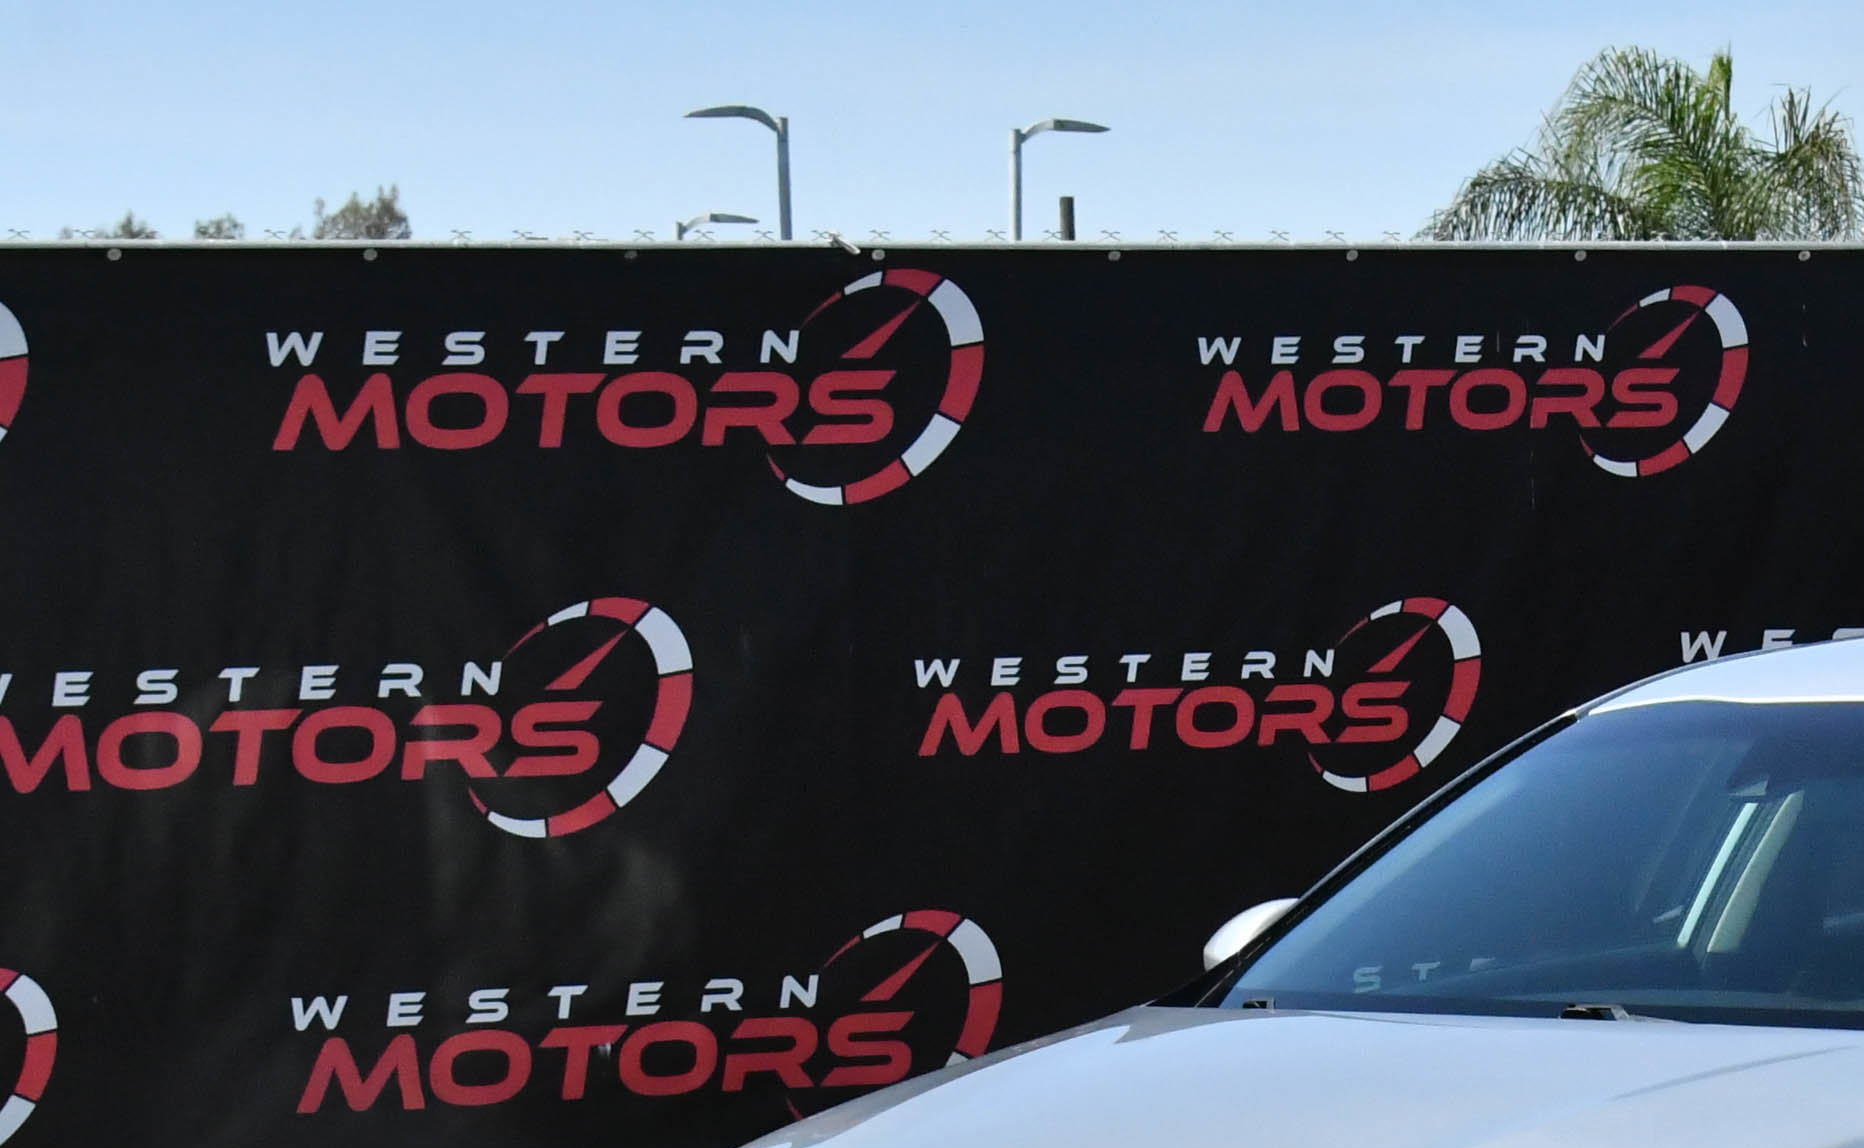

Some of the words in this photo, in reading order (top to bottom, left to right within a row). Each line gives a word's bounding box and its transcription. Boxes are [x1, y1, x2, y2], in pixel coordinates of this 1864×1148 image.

[267, 330, 799, 367] WESTERN
[1198, 334, 1606, 365] WESTERN
[274, 371, 896, 451] MOTORS
[1204, 368, 1680, 432] MOTORS
[0, 662, 502, 707] ESTERN
[914, 649, 1335, 688] WESTERN
[0, 701, 601, 794] MOTORS
[919, 682, 1411, 757] MOTORS
[292, 974, 820, 1031] WESTERN
[298, 1010, 914, 1114] MOTORS
